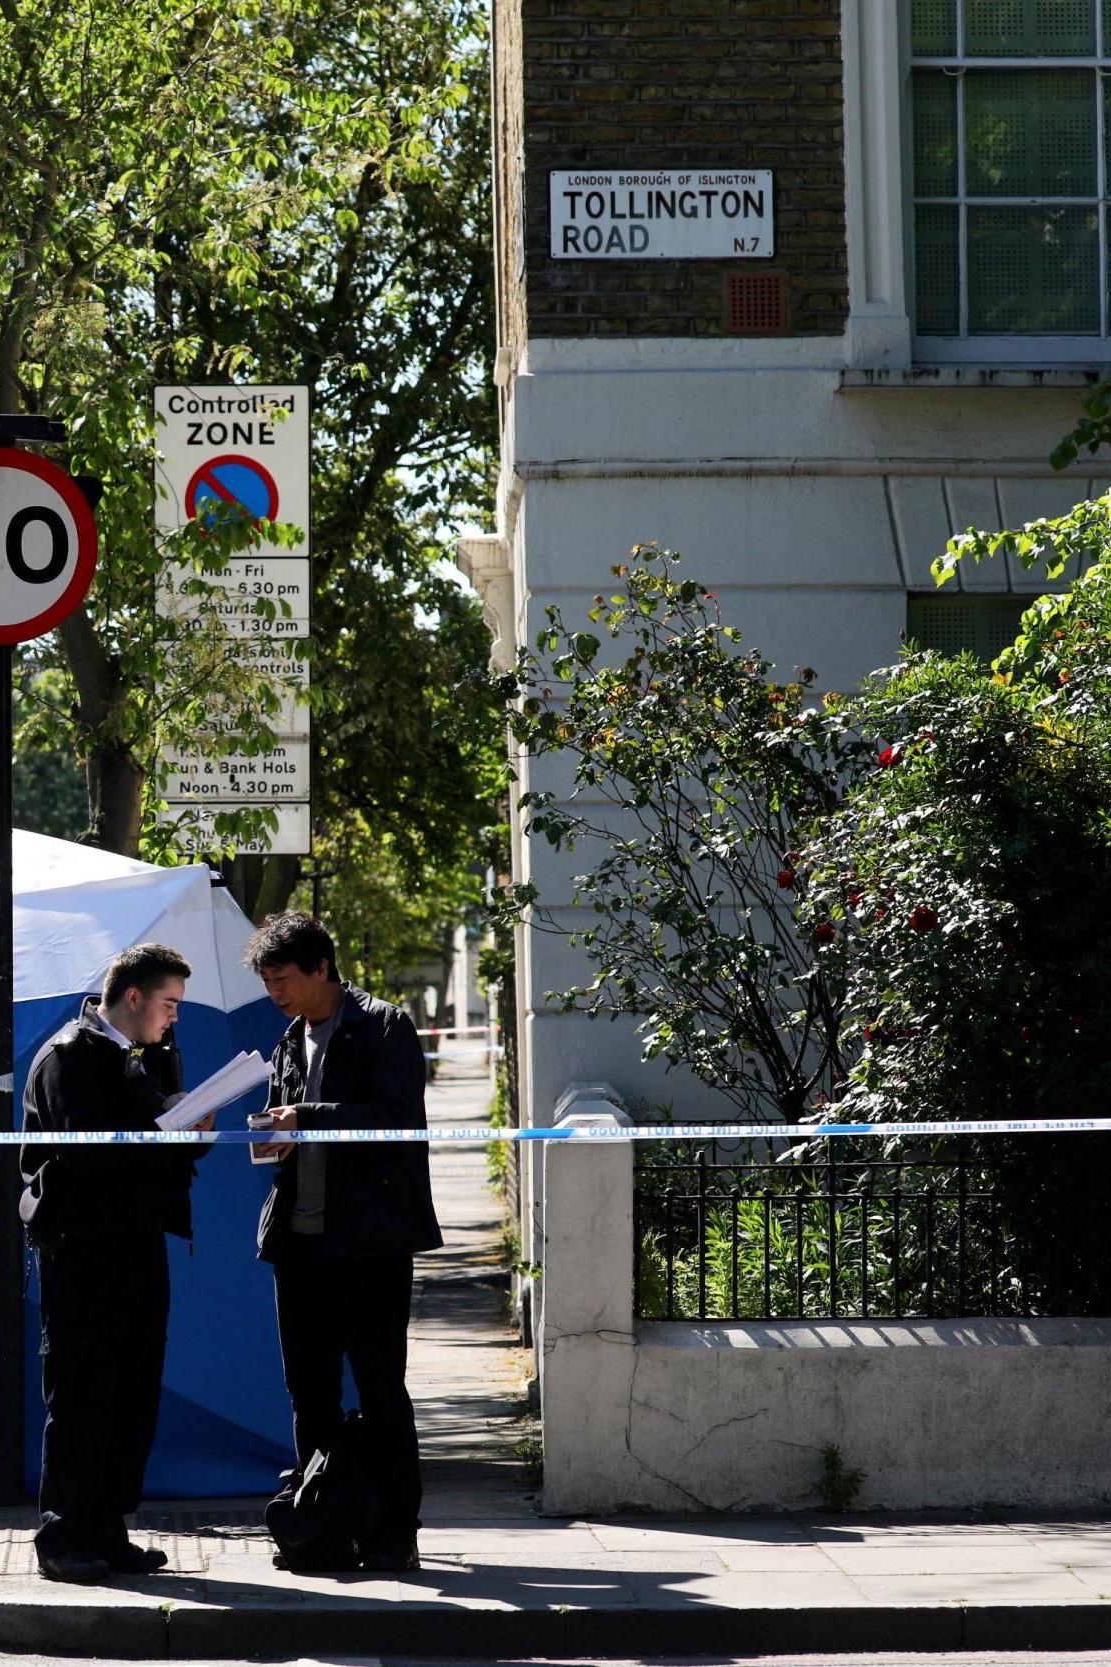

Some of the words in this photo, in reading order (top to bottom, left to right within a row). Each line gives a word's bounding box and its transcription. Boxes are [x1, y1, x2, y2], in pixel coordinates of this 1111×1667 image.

[568, 175, 612, 186] LONDON
[619, 175, 671, 185] BOROUGH
[678, 175, 692, 185] OF
[698, 175, 756, 185] ISLINGTON
[563, 190, 764, 219] TOLLINGTON
[563, 225, 650, 253] ROAD
[733, 237, 761, 252] N.7
[187, 422, 276, 445] ZONE
[245, 564, 264, 577] Fri
[277, 585, 300, 596] pm
[240, 619, 272, 632] 1.30
[276, 621, 299, 634] pm
[204, 761, 214, 774] &
[219, 761, 257, 774] Bank
[263, 761, 296, 774] Hols
[179, 781, 219, 794] Noon
[230, 780, 268, 794] 4.30
[271, 783, 293, 795] pm
